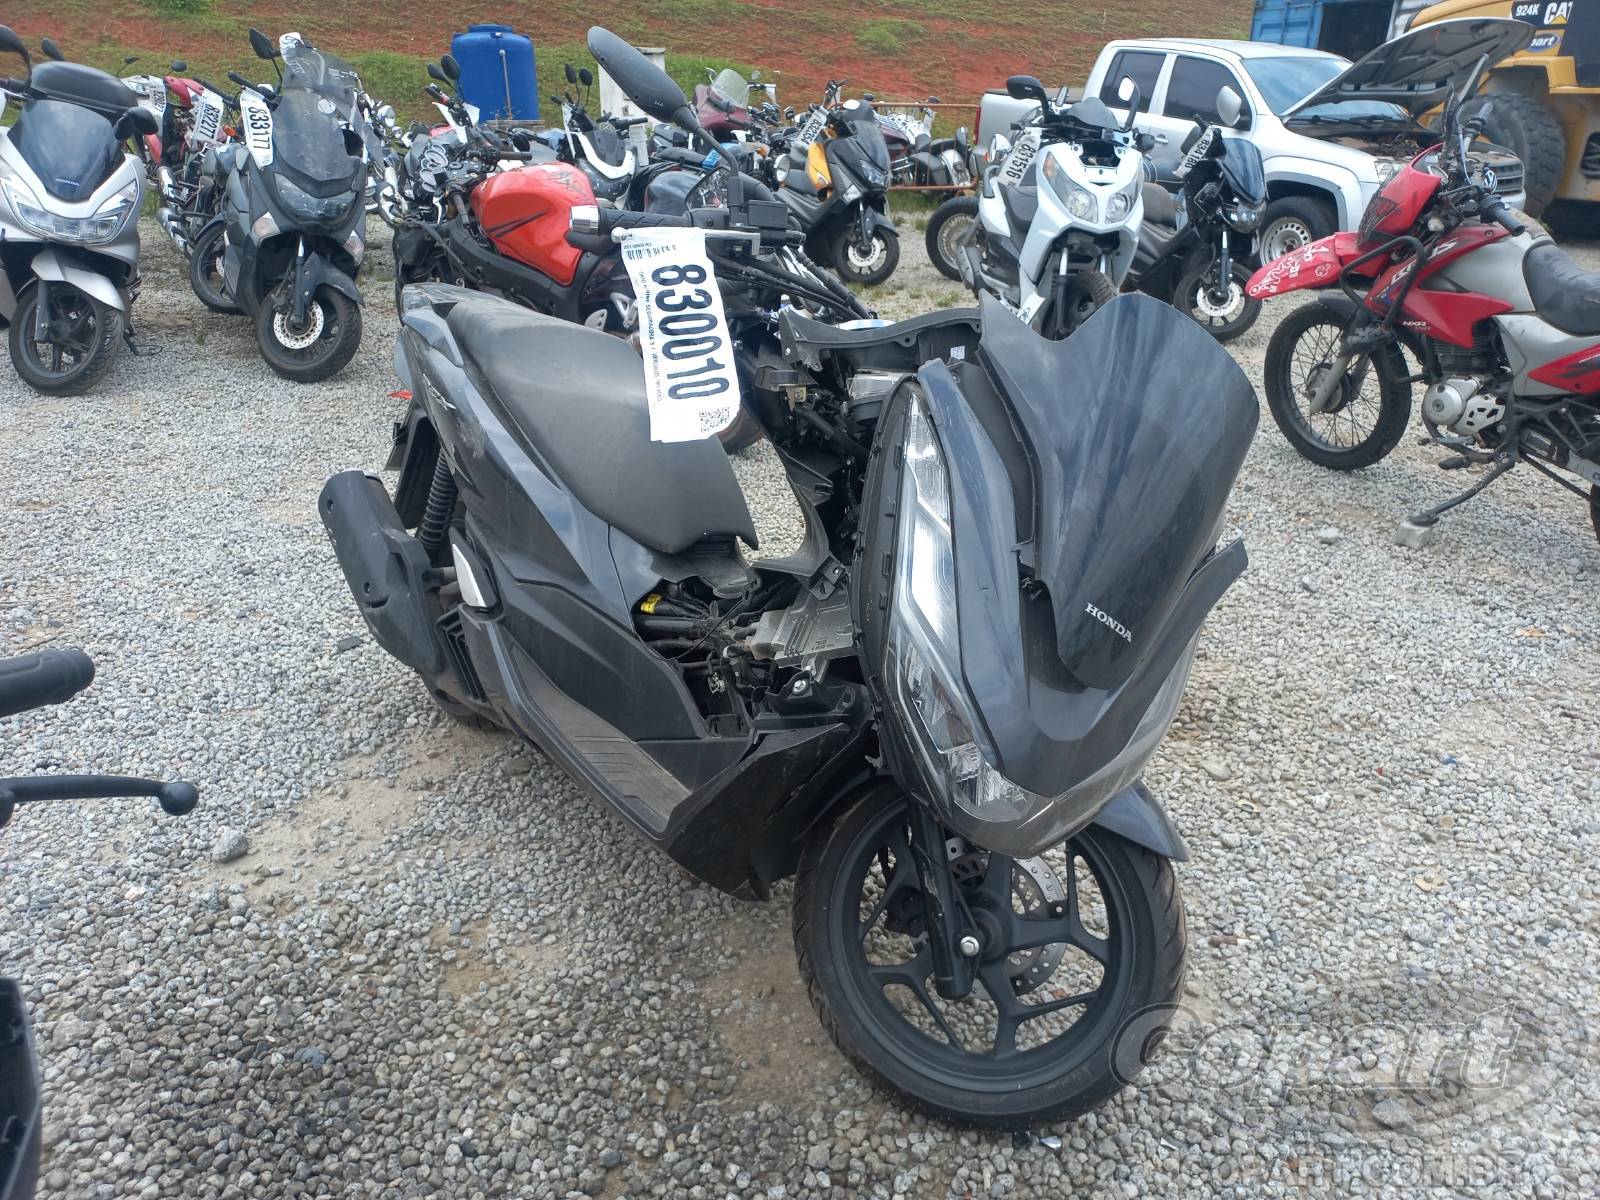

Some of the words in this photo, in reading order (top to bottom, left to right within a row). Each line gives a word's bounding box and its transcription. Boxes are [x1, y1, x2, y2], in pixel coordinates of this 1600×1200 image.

[1516, 4, 1540, 17] 924K
[248, 106, 271, 150] 833177
[1006, 144, 1036, 179] 831516
[651, 264, 730, 400] 830010
[1084, 602, 1132, 643] HONDA
